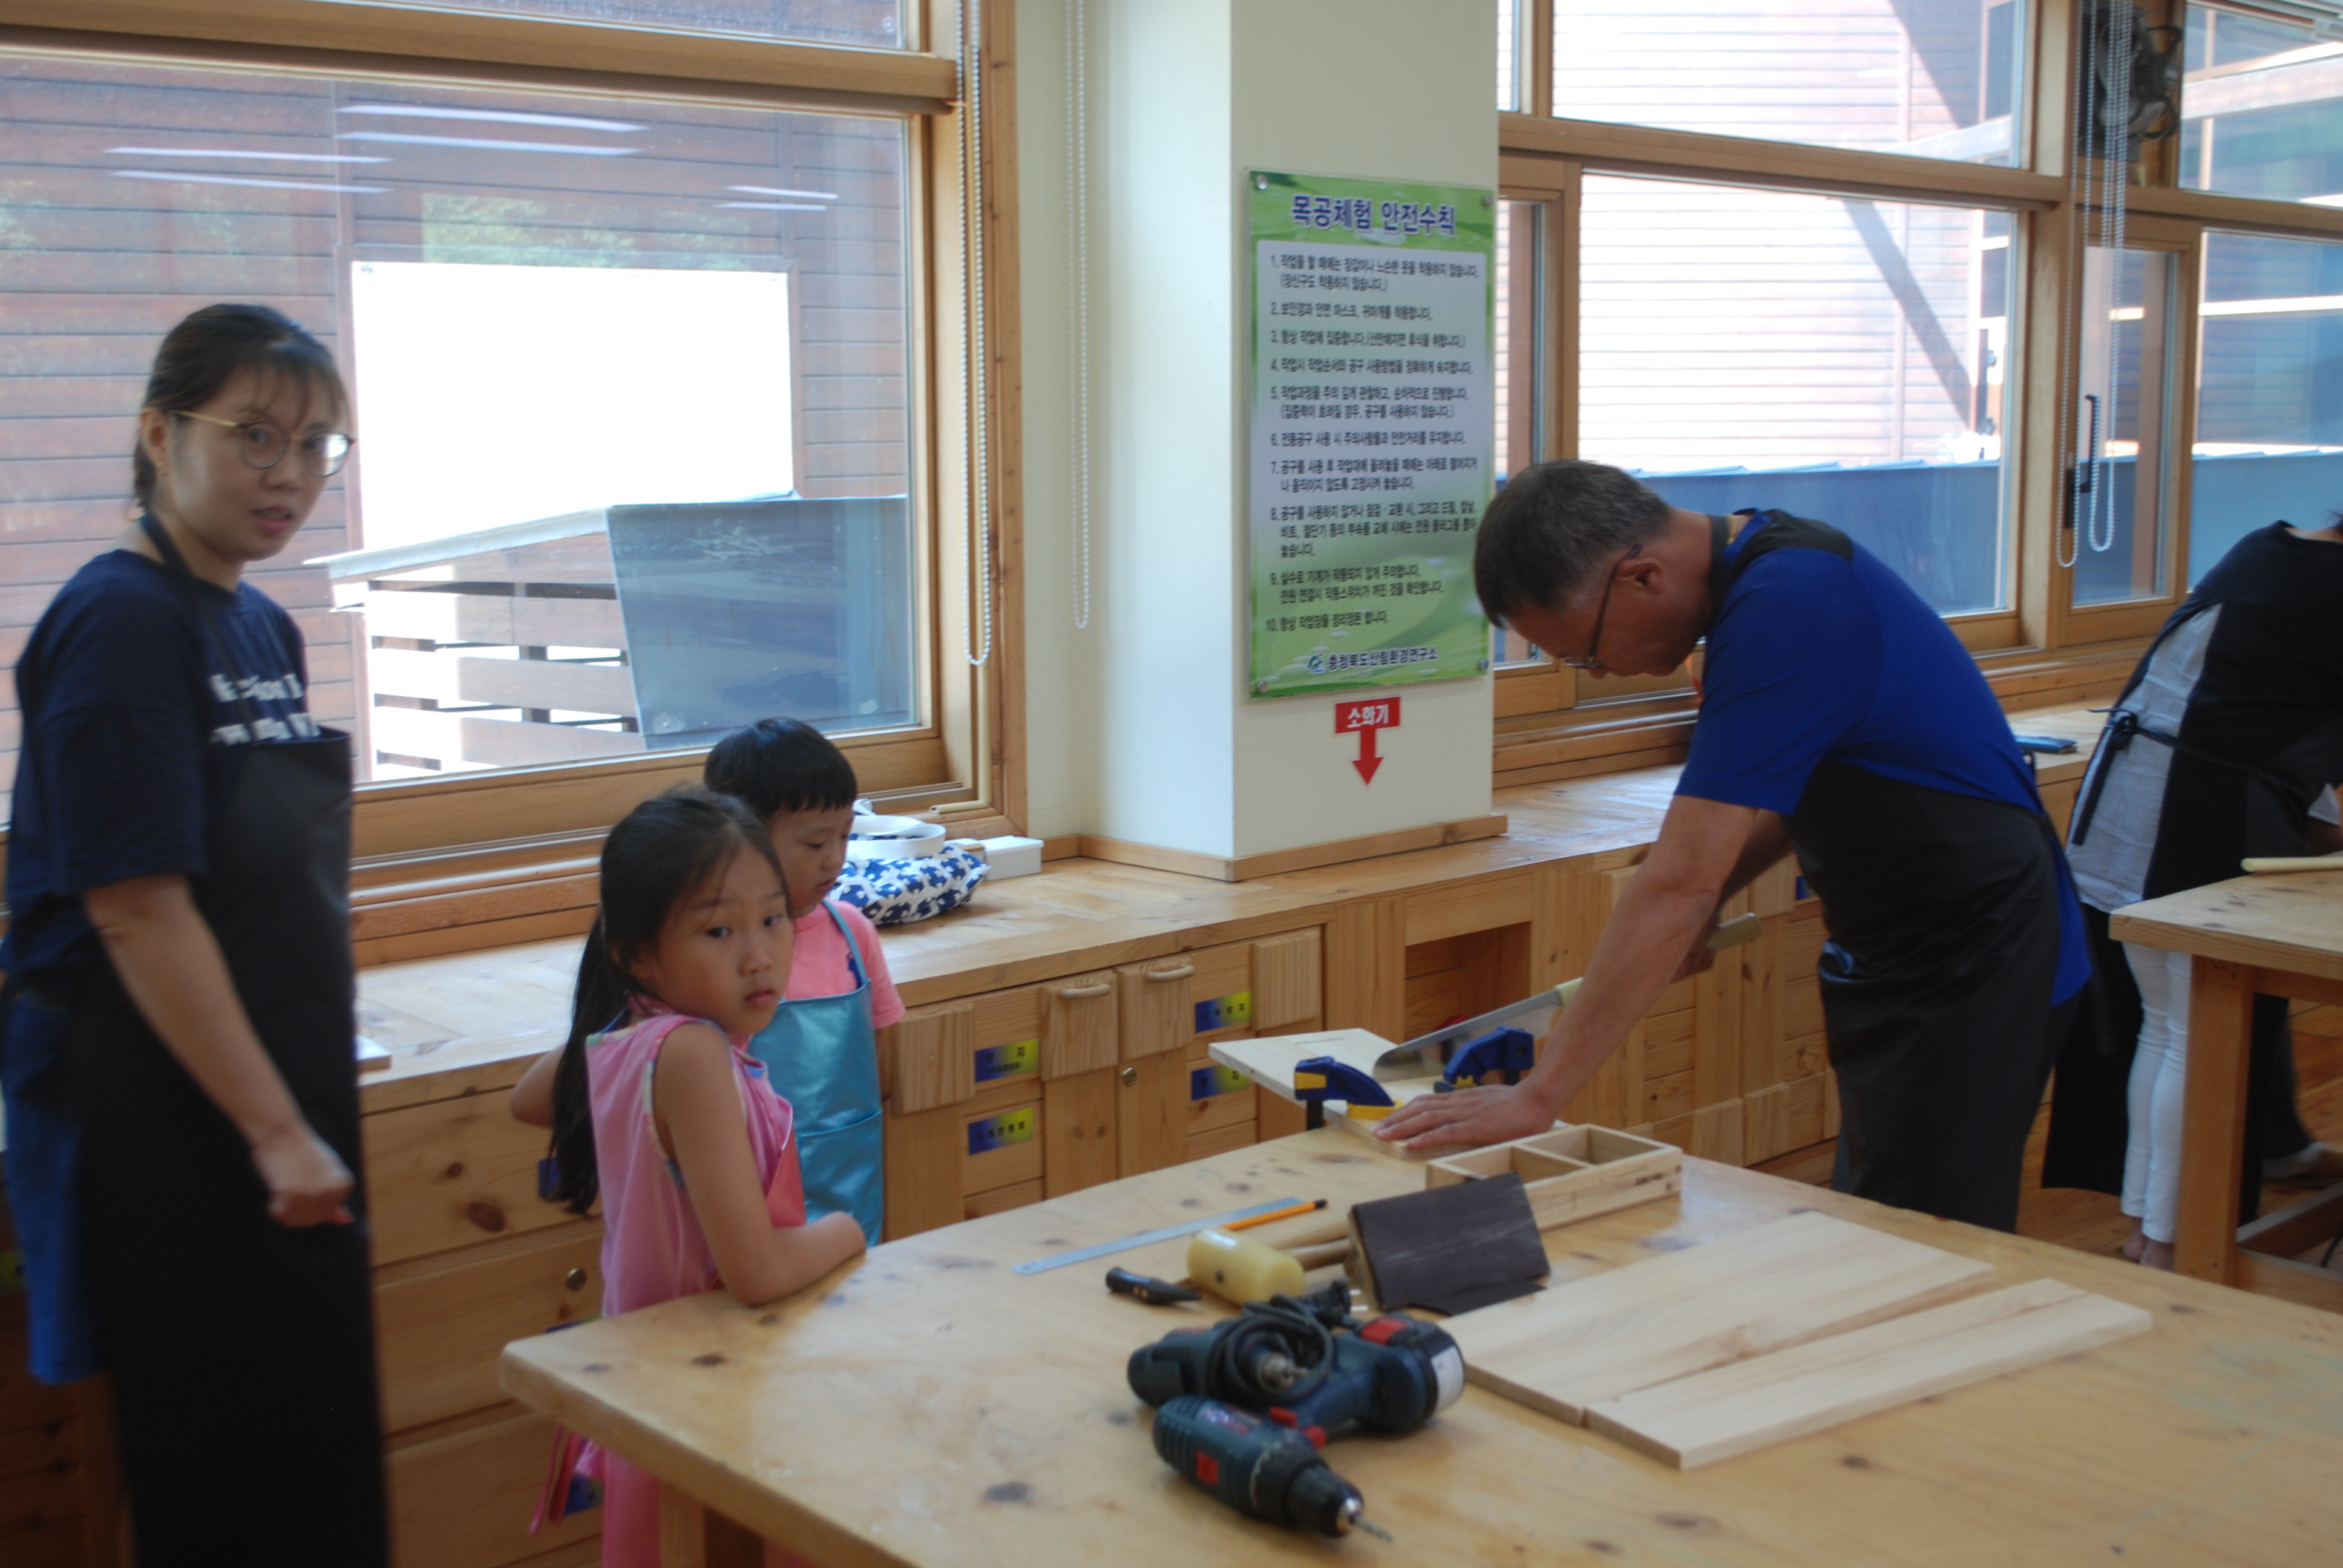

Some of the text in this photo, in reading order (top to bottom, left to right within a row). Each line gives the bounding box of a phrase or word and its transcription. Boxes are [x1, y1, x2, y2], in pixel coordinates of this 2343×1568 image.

[1291, 194, 1456, 237] 목공체험 안전수칙
[1271, 254, 1279, 268] 1.
[1281, 254, 1303, 269] 작업을
[1344, 258, 1374, 272] 장갑이나
[1377, 259, 1399, 274] 느슨한
[1418, 261, 1447, 276] 착용하지
[1319, 274, 1349, 290] 착용하지
[1270, 302, 1279, 315] 2.
[1281, 302, 1312, 316] 보안경과
[1281, 329, 1297, 344] 항상
[1300, 330, 1323, 345] 작업에
[1270, 358, 1279, 372] 4.
[1349, 359, 1364, 374] 공구
[1365, 404, 1386, 419] 공구를
[1390, 404, 1418, 419] 사용하지
[1316, 432, 1331, 447] 사용
[1271, 461, 1279, 474] 7.
[1281, 460, 1305, 475] 공구를
[1308, 459, 1324, 474] 사용
[1281, 506, 1305, 521] 공구를
[1308, 505, 1339, 520] 사용하지
[1280, 616, 1297, 632] 항상
[1328, 645, 1438, 670] 충청북도산림환경연구소
[1346, 704, 1389, 728] 소화기
